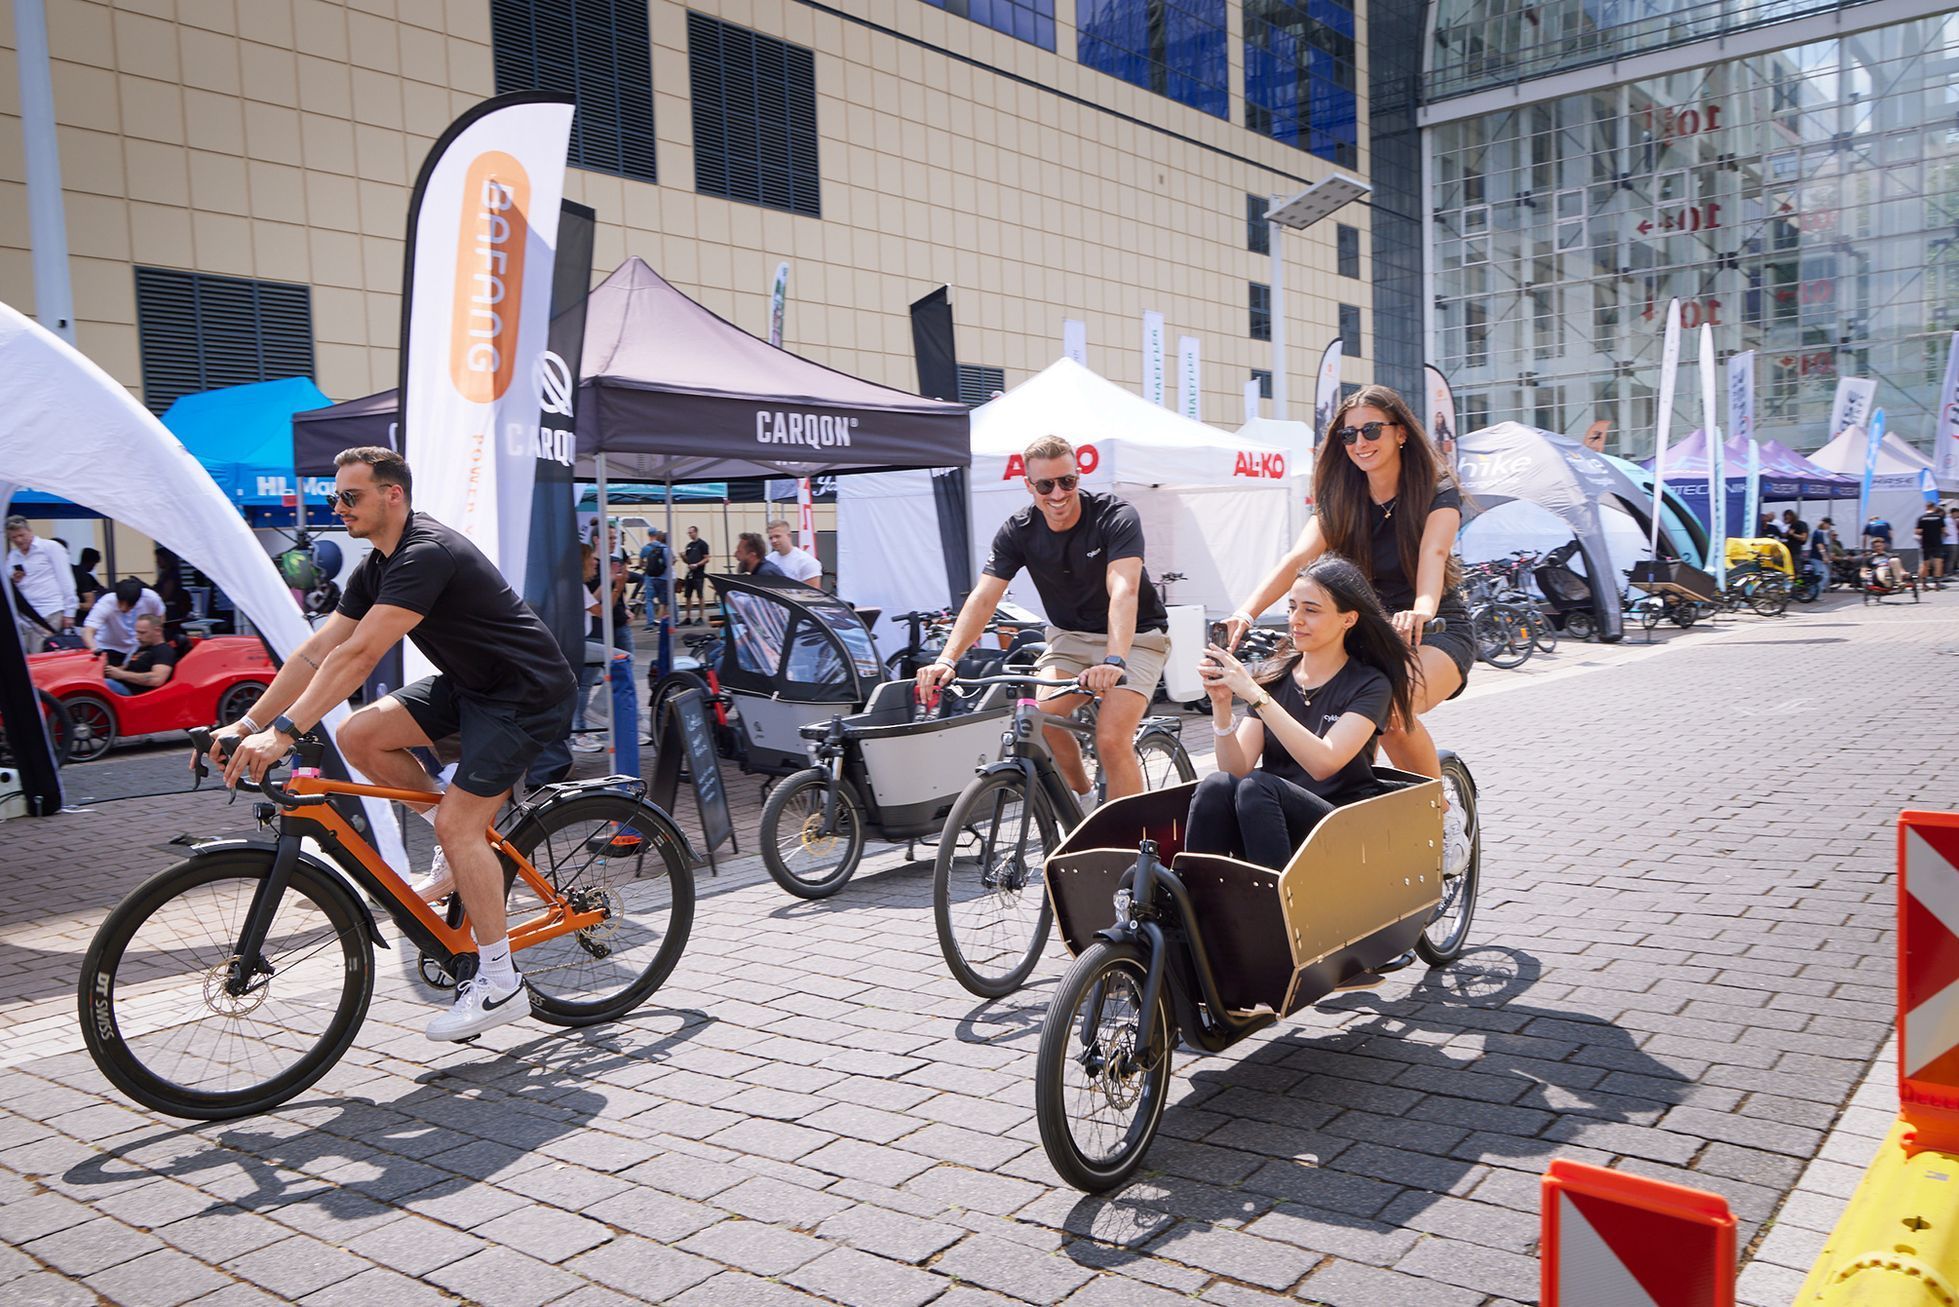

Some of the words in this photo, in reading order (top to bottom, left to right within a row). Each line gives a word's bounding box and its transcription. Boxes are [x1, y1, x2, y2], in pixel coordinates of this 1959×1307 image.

[466, 179, 514, 373] BAFANG
[95, 971, 110, 997] DT
[95, 999, 115, 1040] SWISS
